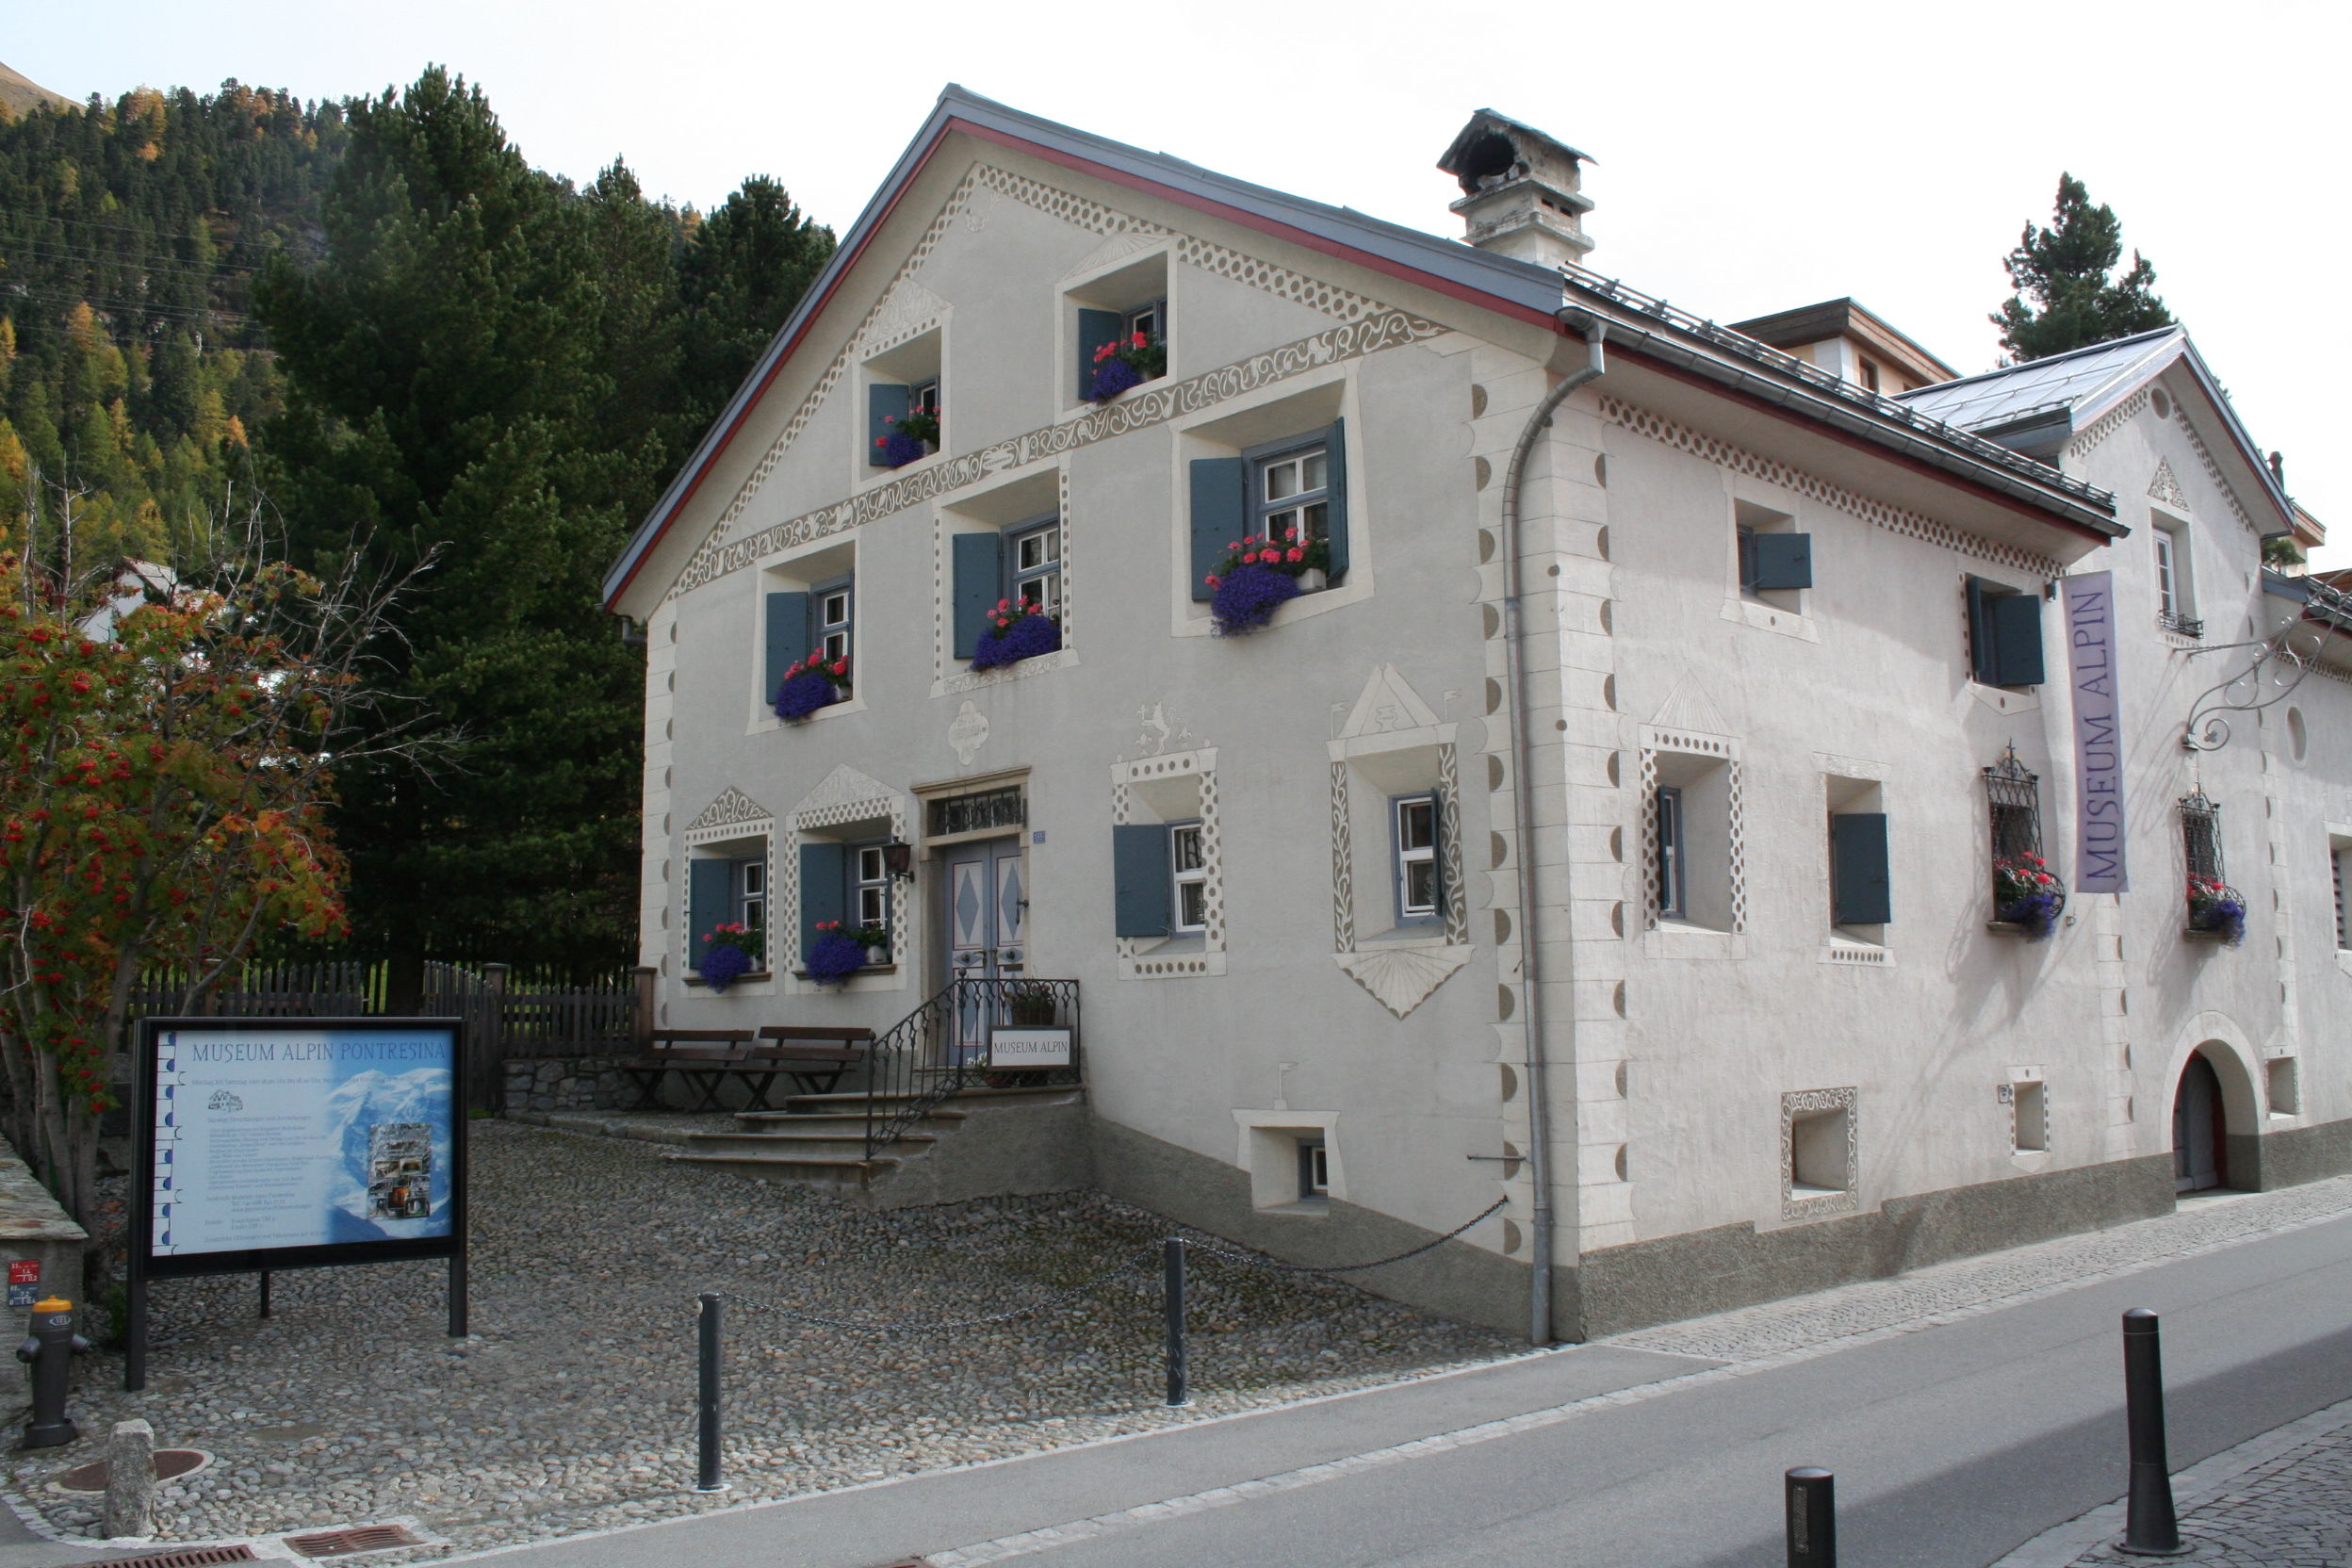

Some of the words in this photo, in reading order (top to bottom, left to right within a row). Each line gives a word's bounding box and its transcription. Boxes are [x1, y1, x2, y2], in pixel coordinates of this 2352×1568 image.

[2071, 592, 2110, 697] ALPIN
[2082, 714, 2119, 879] MUSEUM
[192, 1043, 275, 1063] MUSEUM
[282, 1042, 334, 1061] ALPIN
[340, 1041, 446, 1061] PONTRESINA
[994, 1041, 1037, 1054] MUSEUM
[1040, 1040, 1068, 1053] ALPIN
